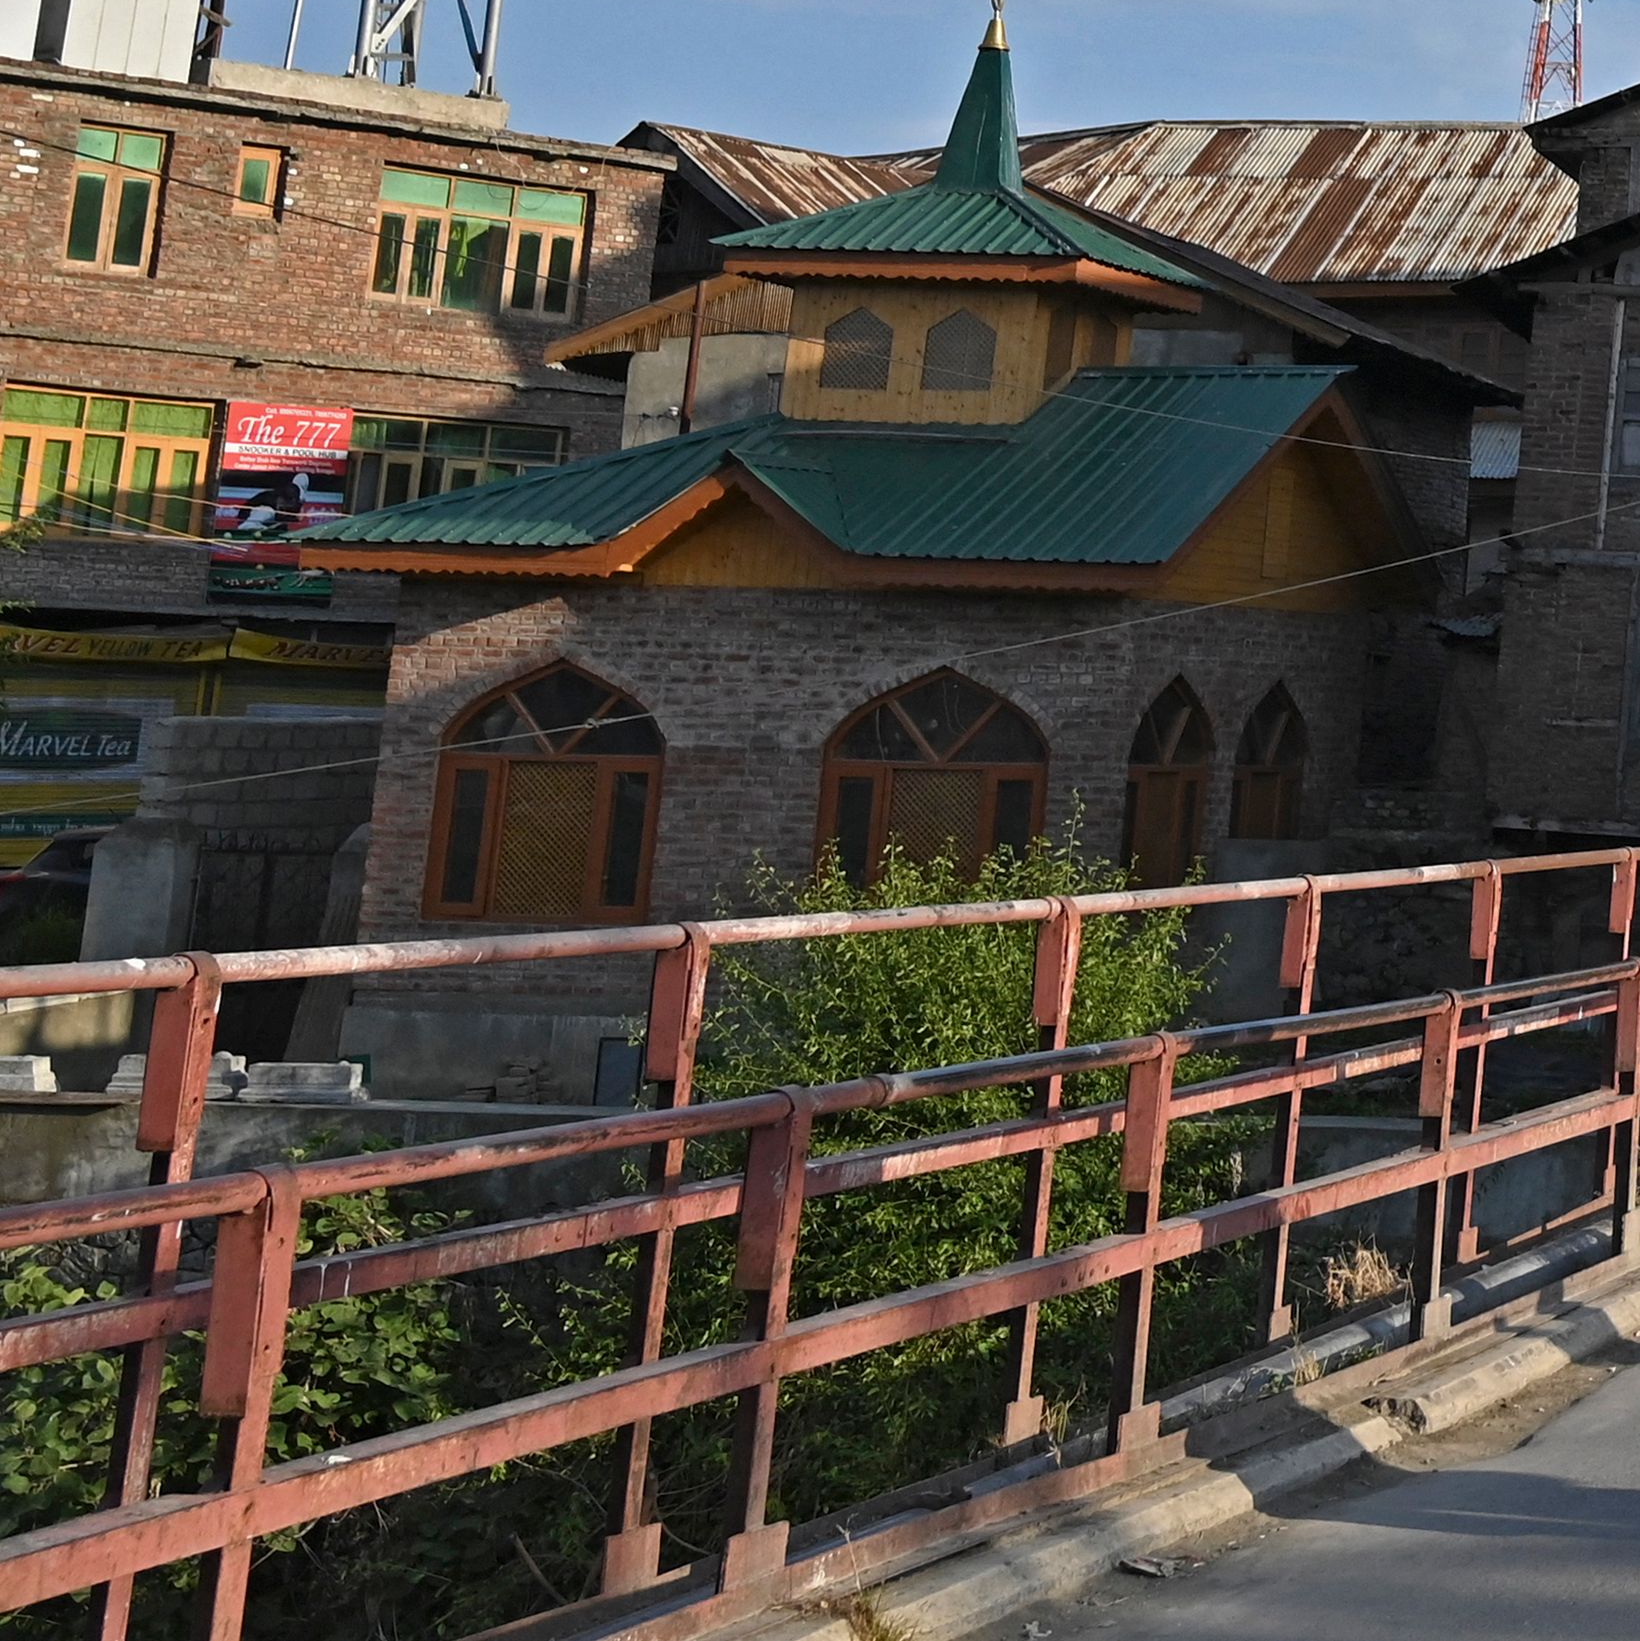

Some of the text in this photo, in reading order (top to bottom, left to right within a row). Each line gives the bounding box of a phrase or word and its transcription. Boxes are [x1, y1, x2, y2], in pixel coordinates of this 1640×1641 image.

[237, 415, 341, 449] The 777
[238, 446, 337, 459] SNOOKER & POOL HUB
[88, 639, 152, 658] YELLOW
[161, 641, 204, 658] TEA
[0, 719, 131, 756] MARVEL Tea
